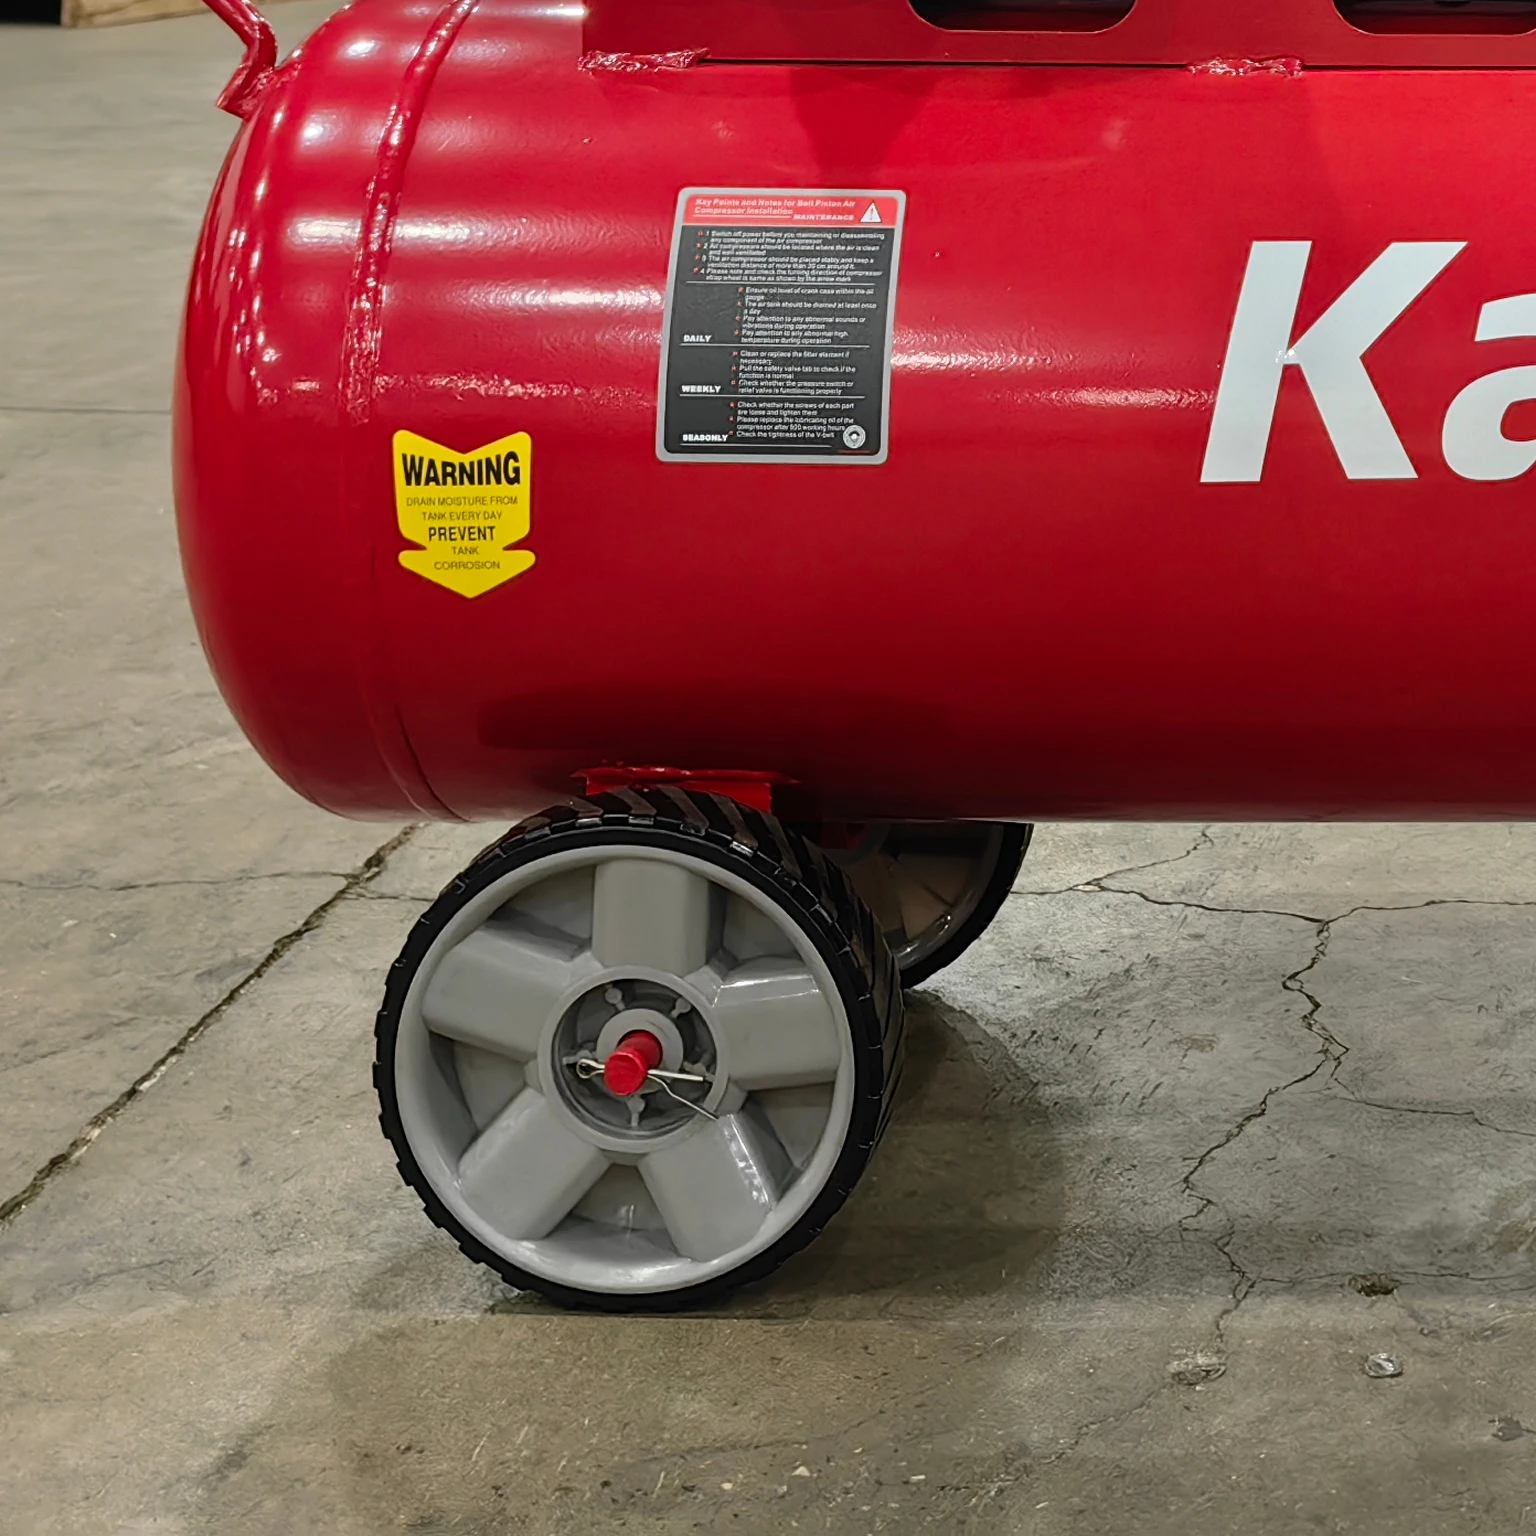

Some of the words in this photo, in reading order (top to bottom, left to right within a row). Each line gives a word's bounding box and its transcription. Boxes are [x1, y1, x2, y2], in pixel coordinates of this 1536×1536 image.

[696, 199, 711, 207] Key
[741, 199, 757, 207] and
[758, 199, 782, 207] Notes
[784, 199, 795, 207] for
[683, 334, 712, 342] DAILY
[681, 385, 721, 393] WEEKLY
[402, 451, 520, 486] WARNING
[407, 497, 436, 506] DRAIN
[437, 496, 487, 506] MOISTURE
[490, 496, 518, 505] FROM
[422, 512, 446, 521] TANK
[450, 511, 481, 521] EVERY
[483, 511, 502, 520] DAY
[428, 525, 495, 542] PREVENT
[451, 546, 479, 555] TANK
[434, 561, 500, 570] CORROSION
